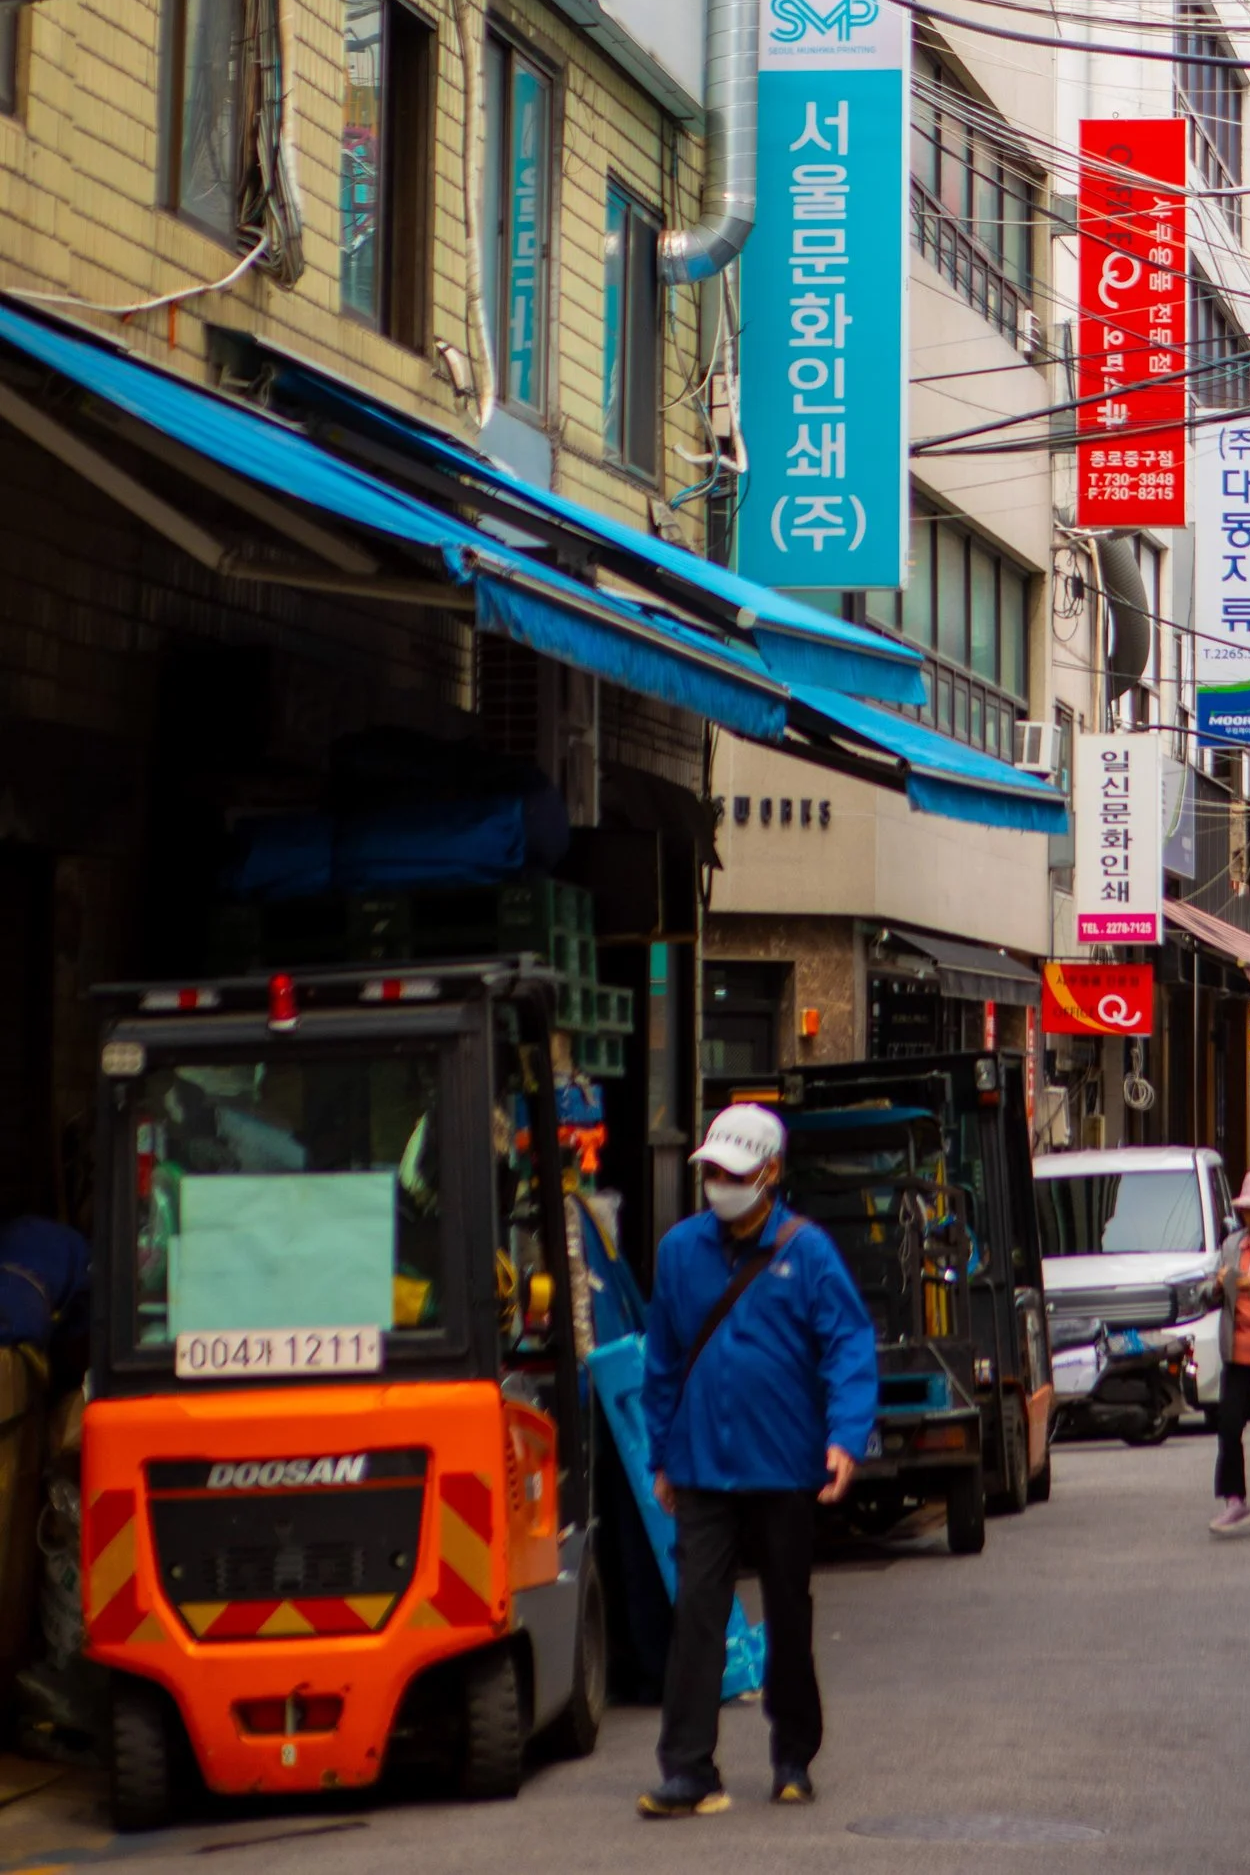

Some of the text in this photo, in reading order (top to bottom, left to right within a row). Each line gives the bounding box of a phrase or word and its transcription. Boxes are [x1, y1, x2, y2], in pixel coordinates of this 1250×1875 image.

[1148, 302, 1173, 375] 전문점
[1089, 450, 1174, 469] 종로중구점
[1099, 749, 1133, 903] 일신문화인쇄
[190, 1332, 361, 1370] 004가 1211
[206, 1452, 368, 1489] DOOSAN
